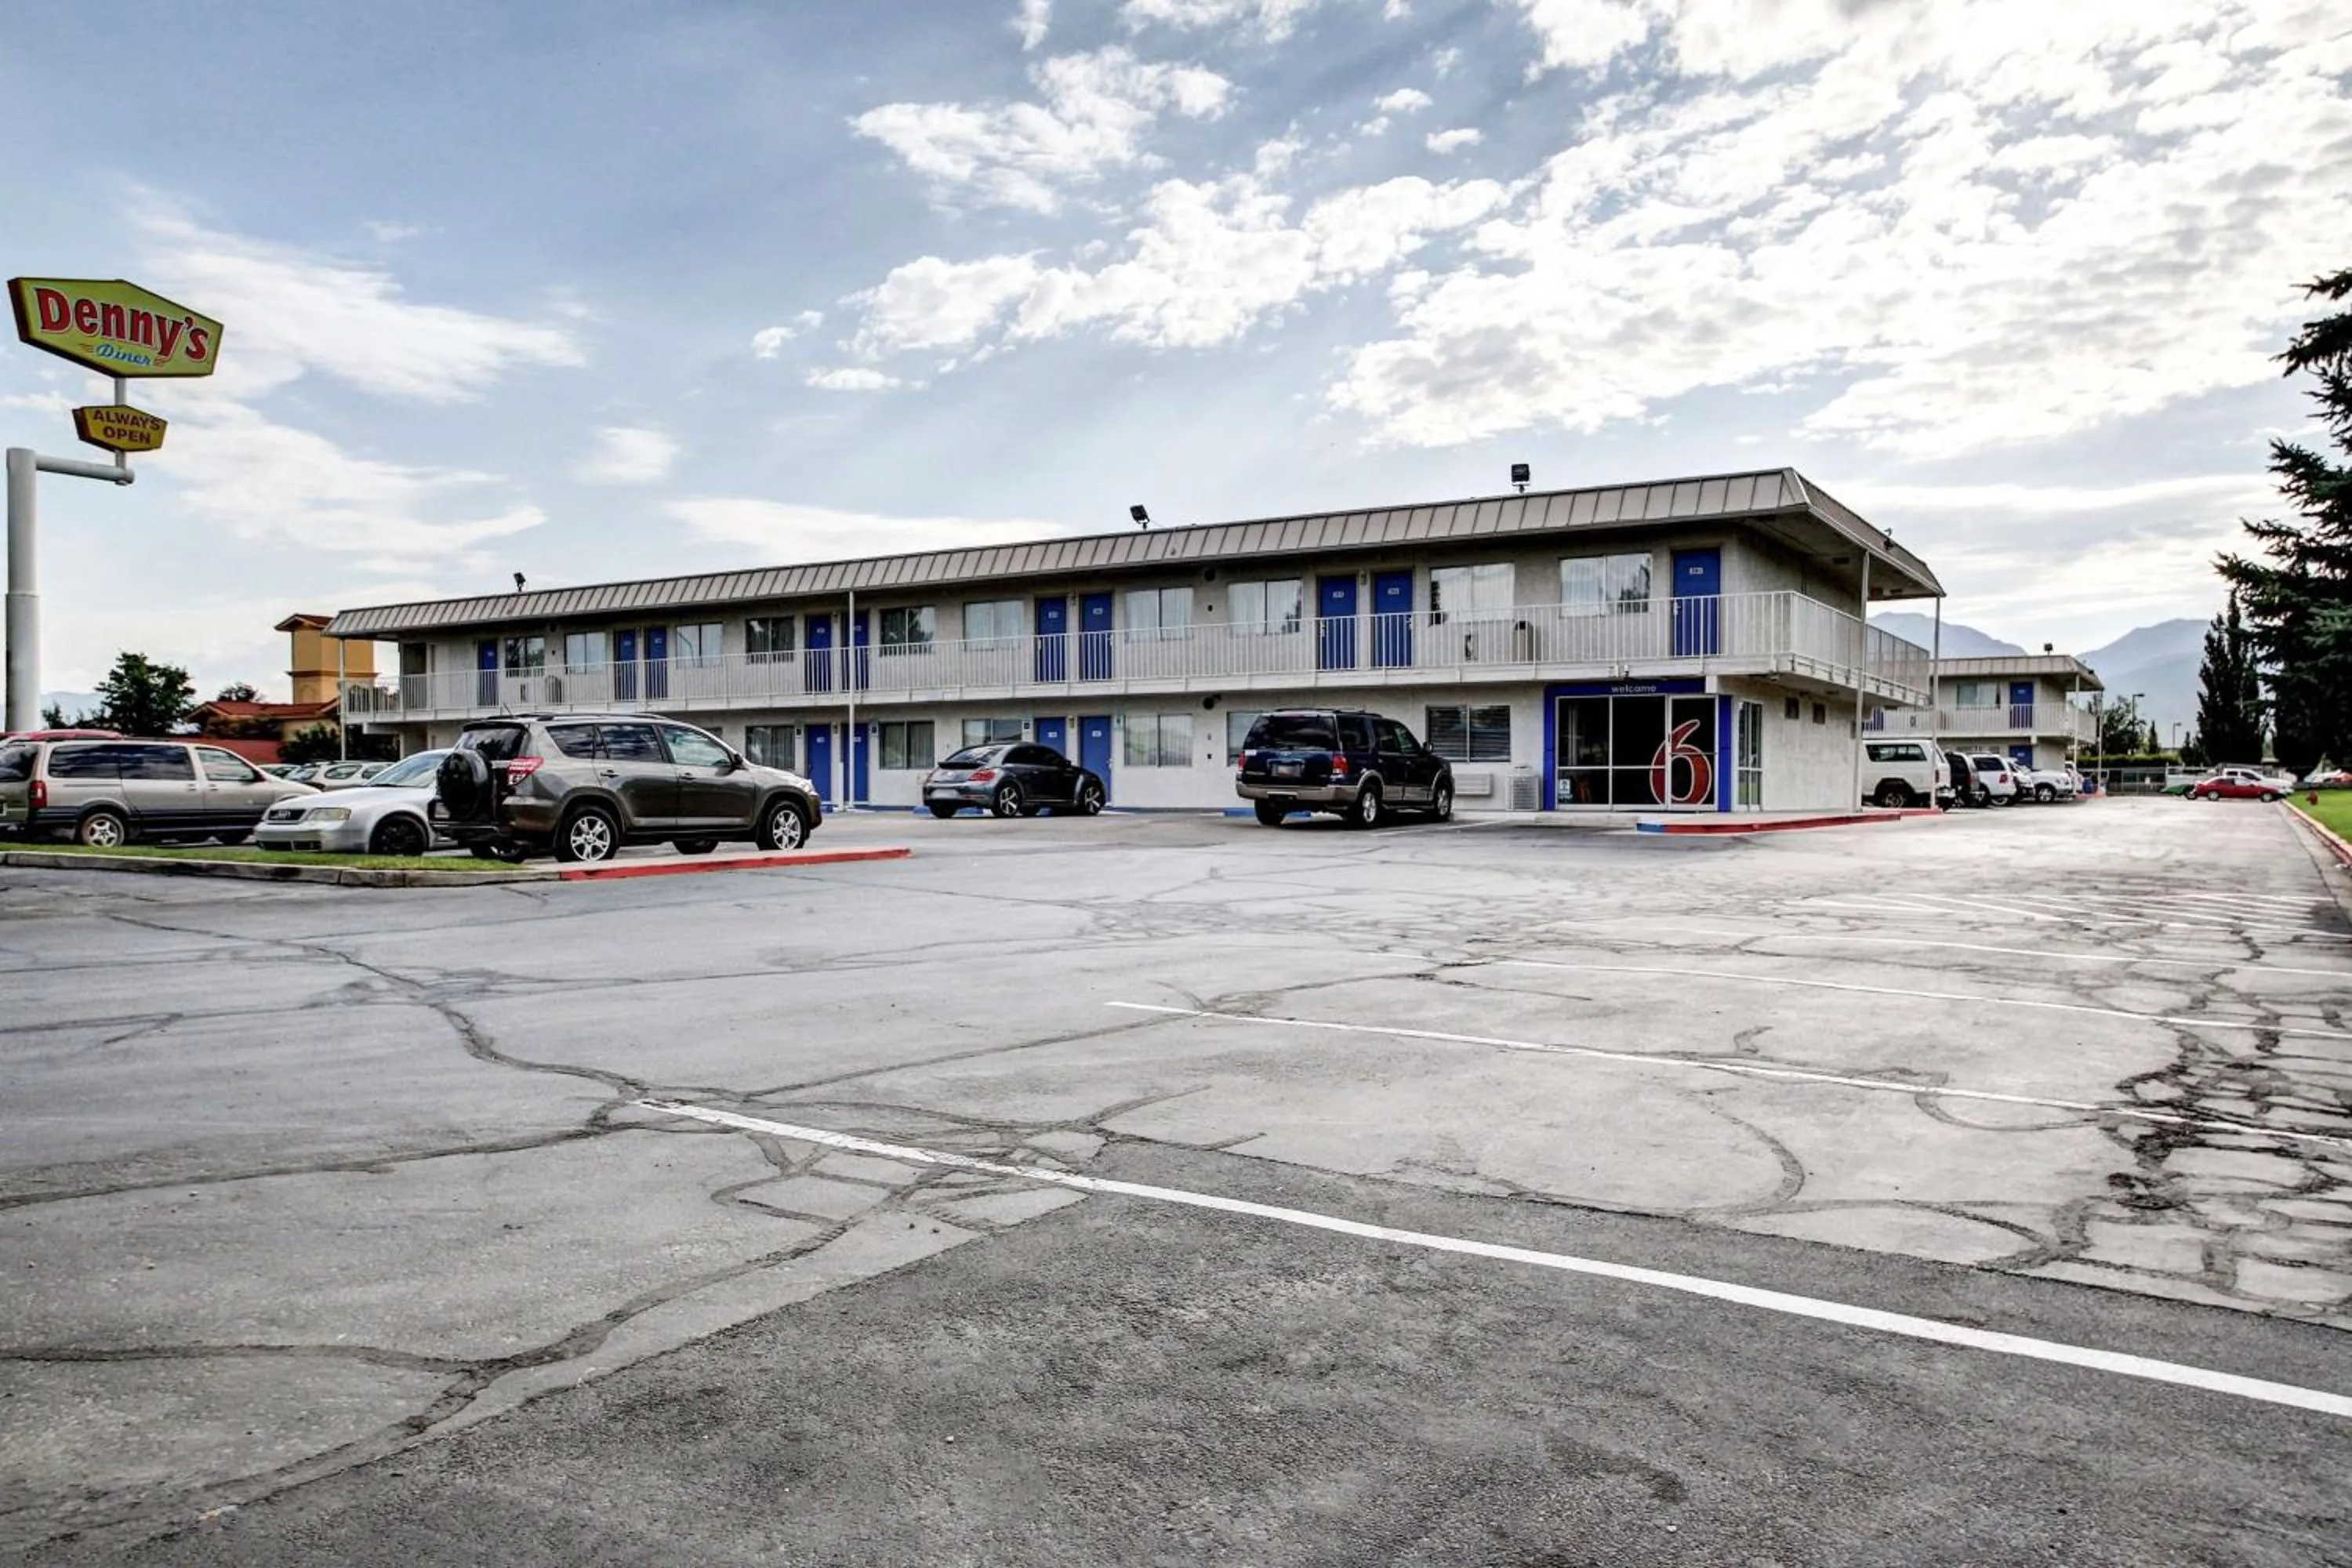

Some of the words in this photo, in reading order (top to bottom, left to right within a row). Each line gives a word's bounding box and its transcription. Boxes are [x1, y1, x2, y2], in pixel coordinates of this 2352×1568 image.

[34, 286, 210, 361] Denny's
[95, 343, 151, 367] Diner
[93, 409, 162, 430] ALWAYS
[102, 426, 152, 445] OPEN
[1611, 684, 1657, 694] welcome
[1649, 718, 1712, 805] 6
